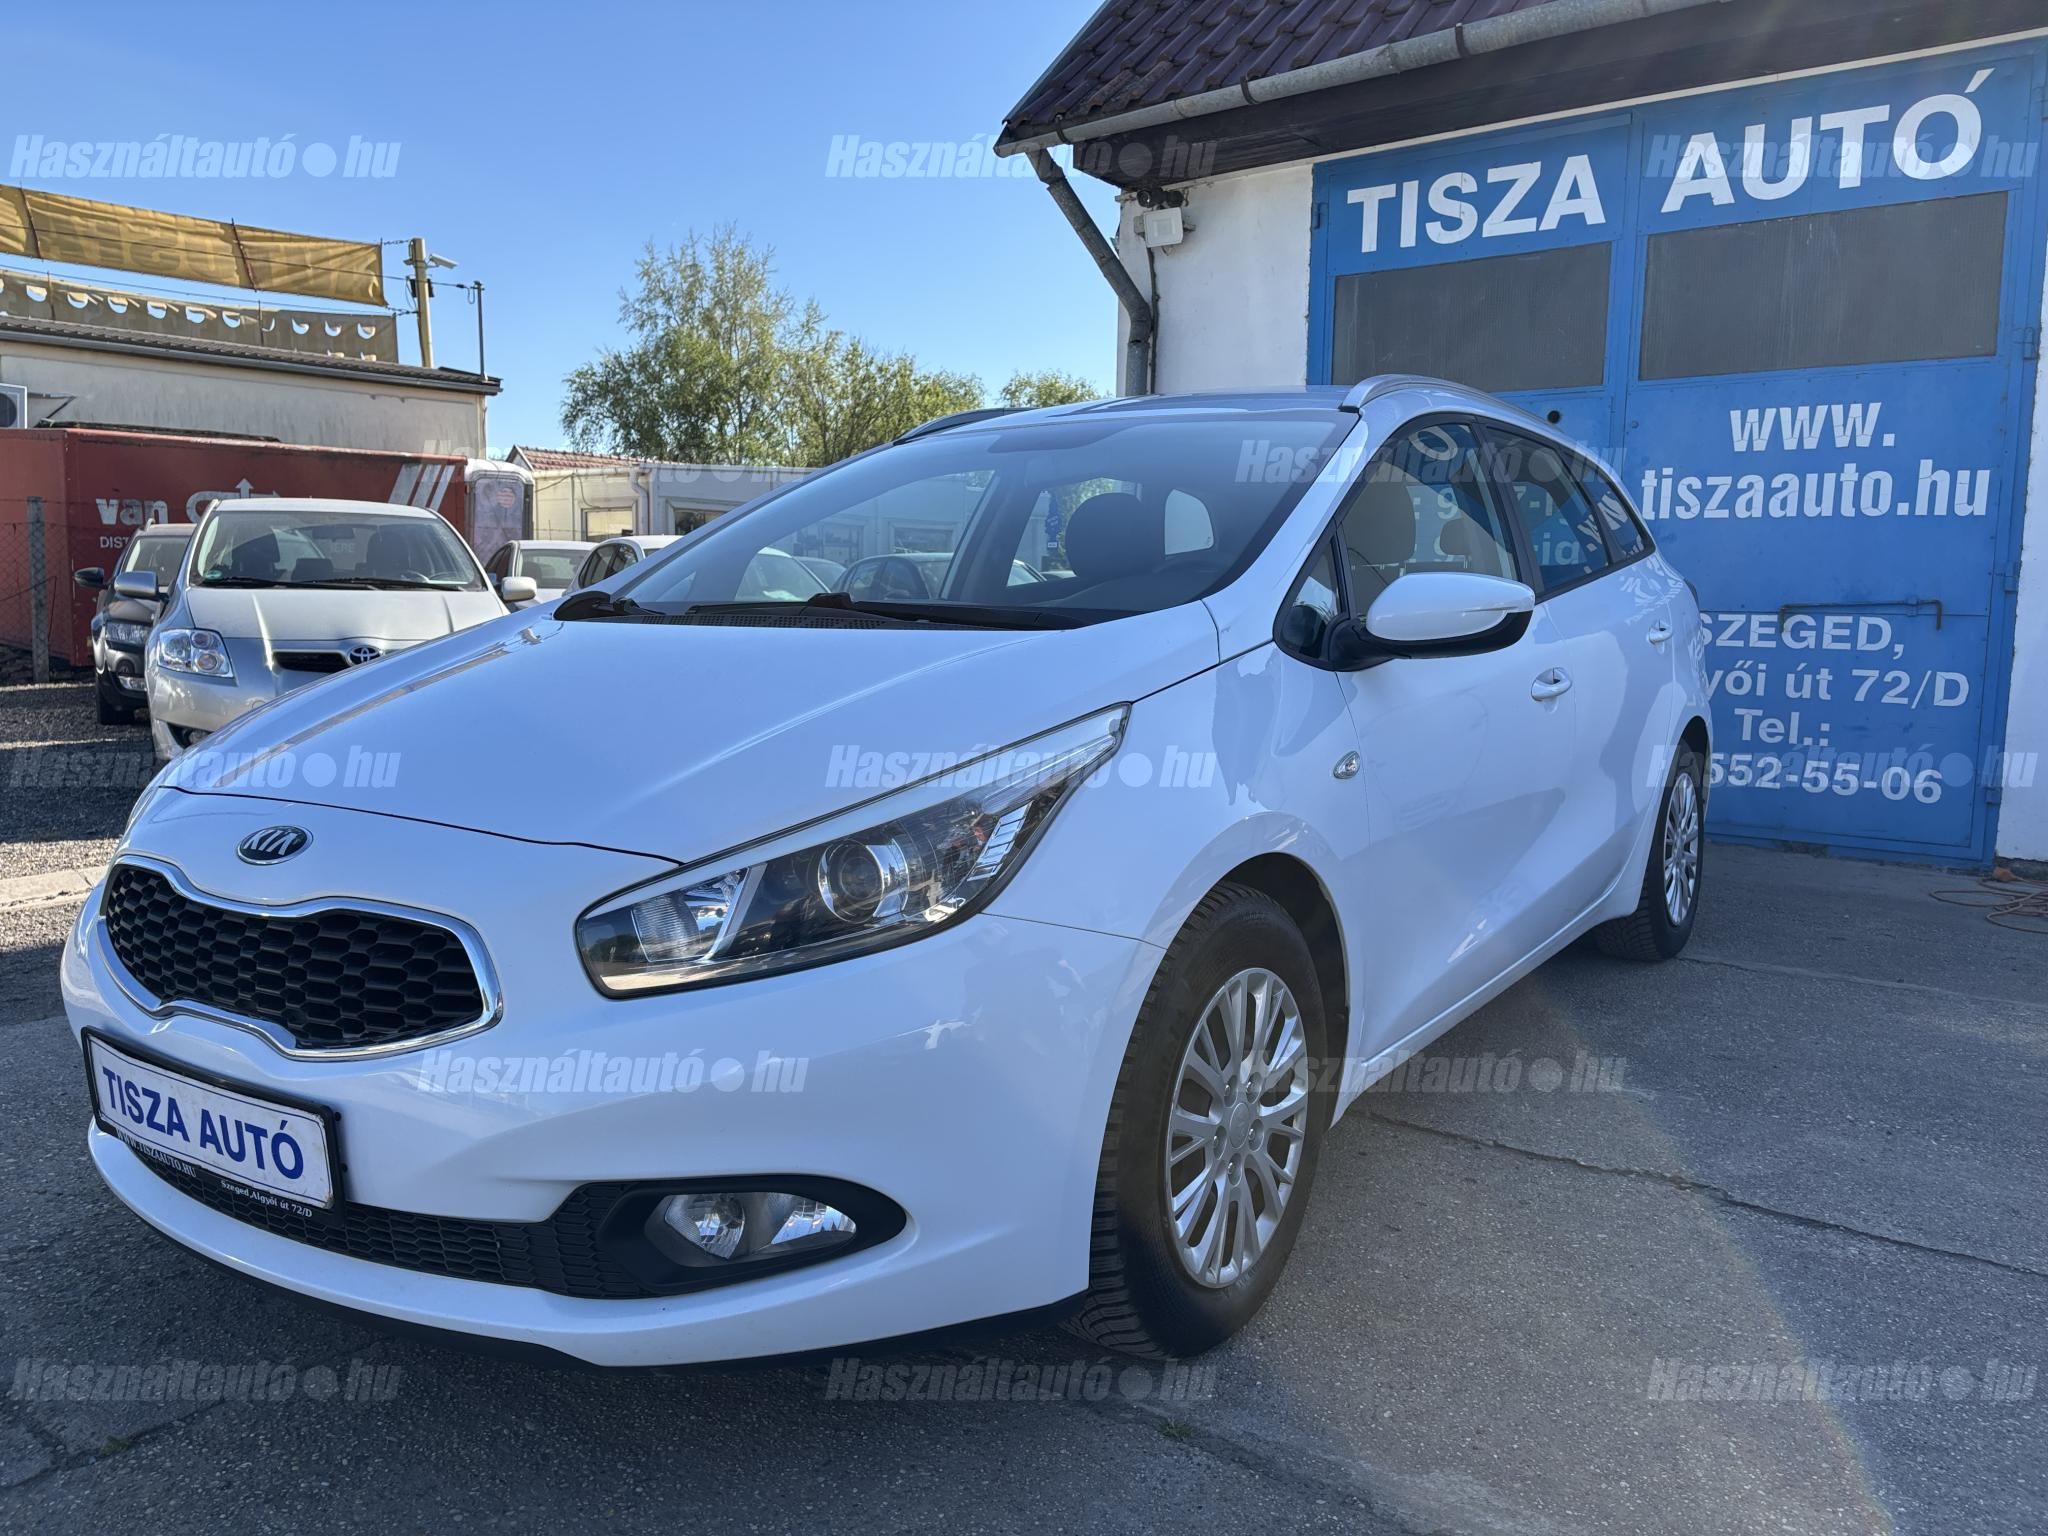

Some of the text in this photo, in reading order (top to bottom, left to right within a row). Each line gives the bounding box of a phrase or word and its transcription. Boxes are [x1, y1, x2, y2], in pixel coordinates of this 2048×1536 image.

[1347, 68, 1996, 253] TISZA AUTÓ
[1729, 402, 1896, 452] www.
[1641, 459, 1991, 520] tiszaauto.hu
[1700, 613, 1905, 660] SZEGED,
[1704, 660, 1970, 710] yői út 72/D
[1734, 707, 1831, 747] Tel.:
[102, 1066, 304, 1180] TISZA AUTÓ
